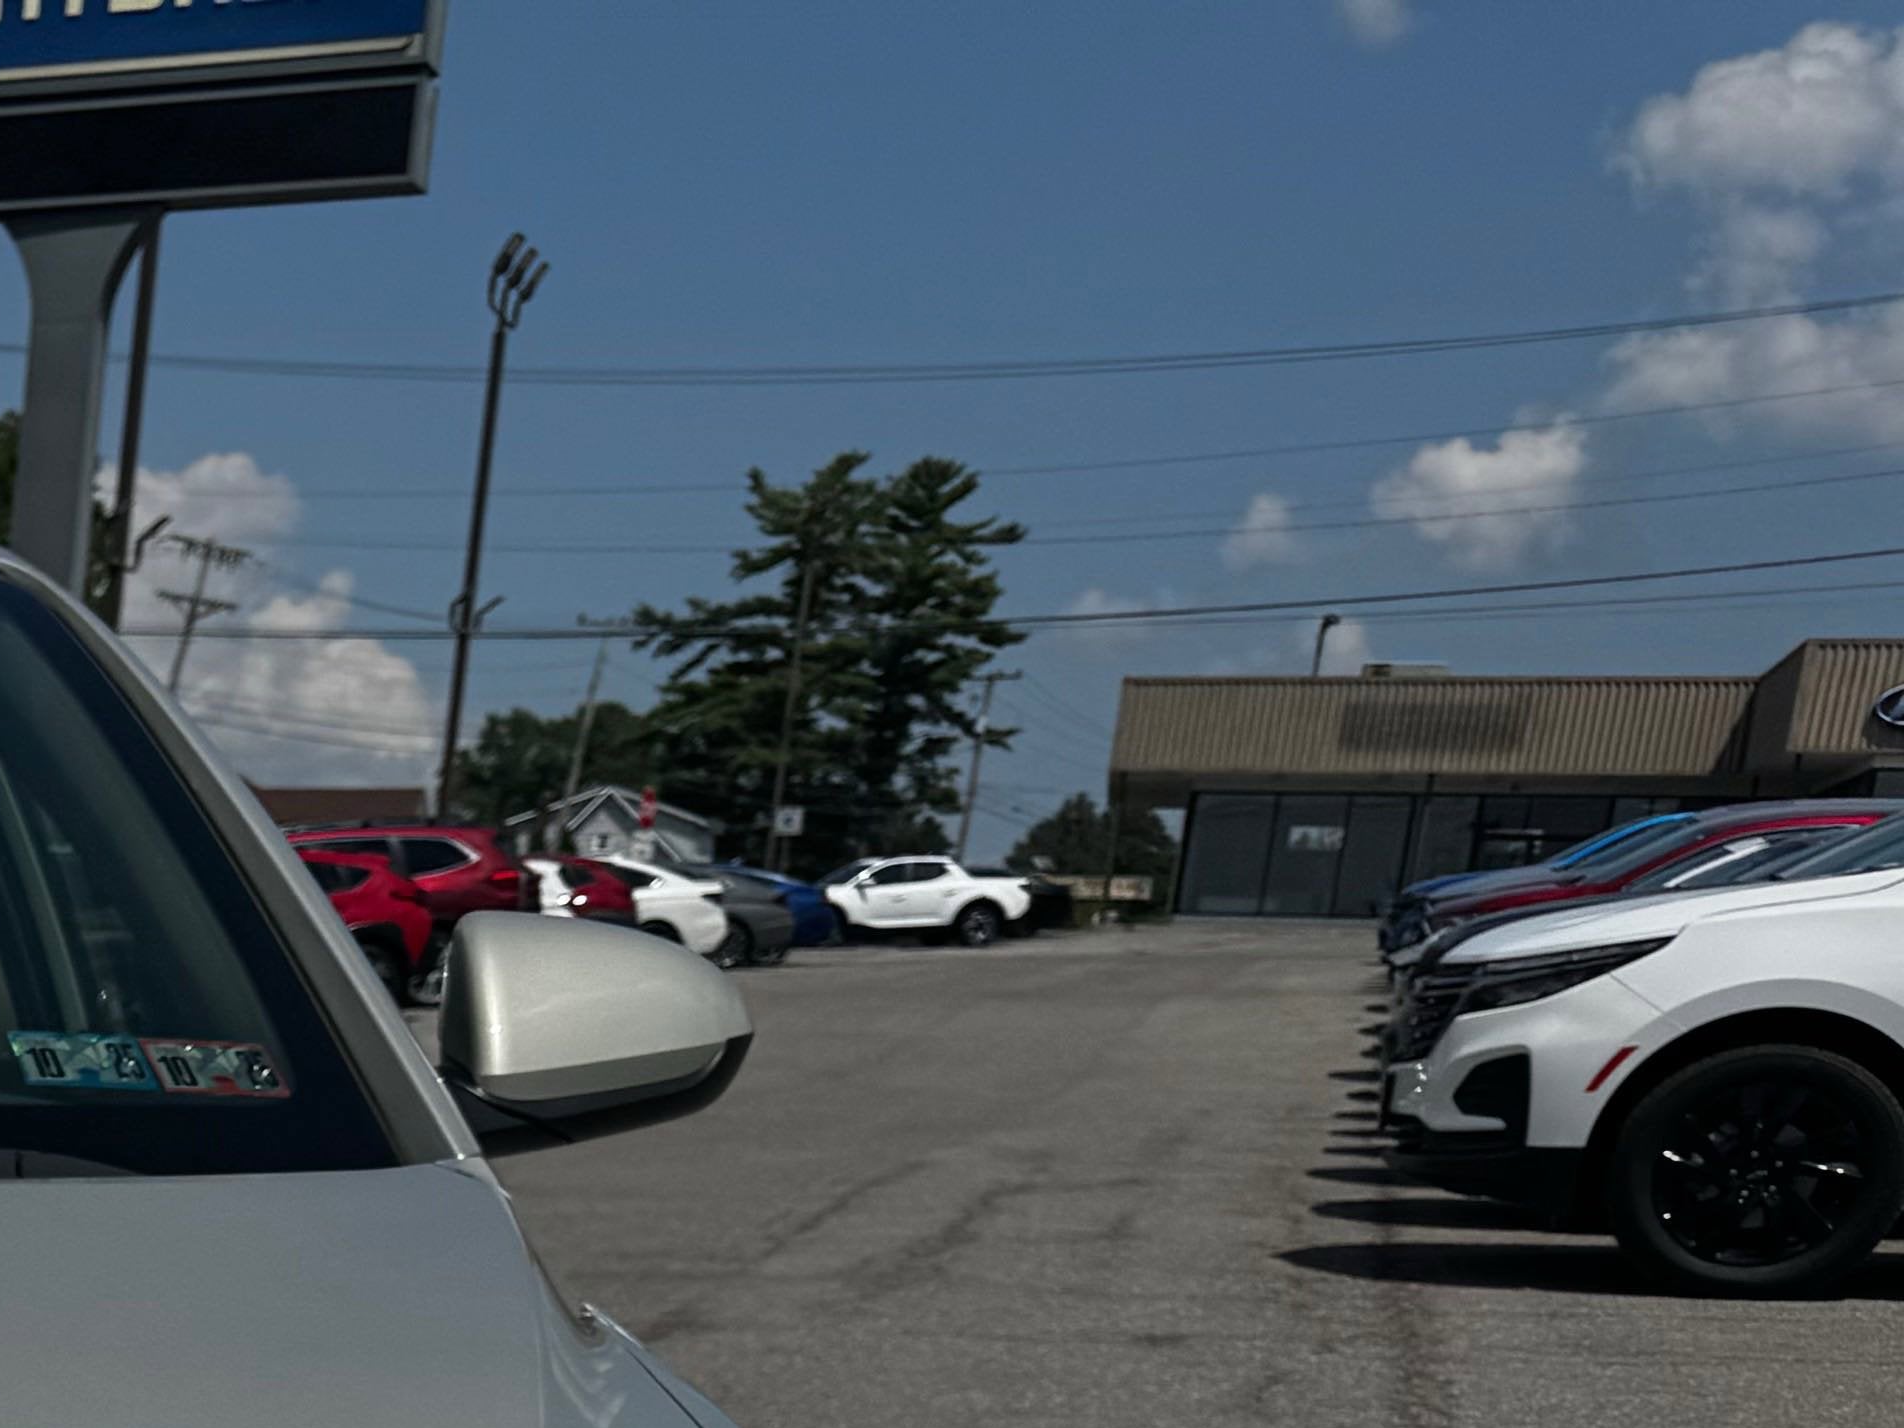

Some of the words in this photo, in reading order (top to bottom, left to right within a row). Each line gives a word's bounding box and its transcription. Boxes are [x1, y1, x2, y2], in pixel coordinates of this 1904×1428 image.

[26, 1048, 66, 1078] 10
[104, 1042, 146, 1079] 25
[157, 1056, 199, 1087] 10
